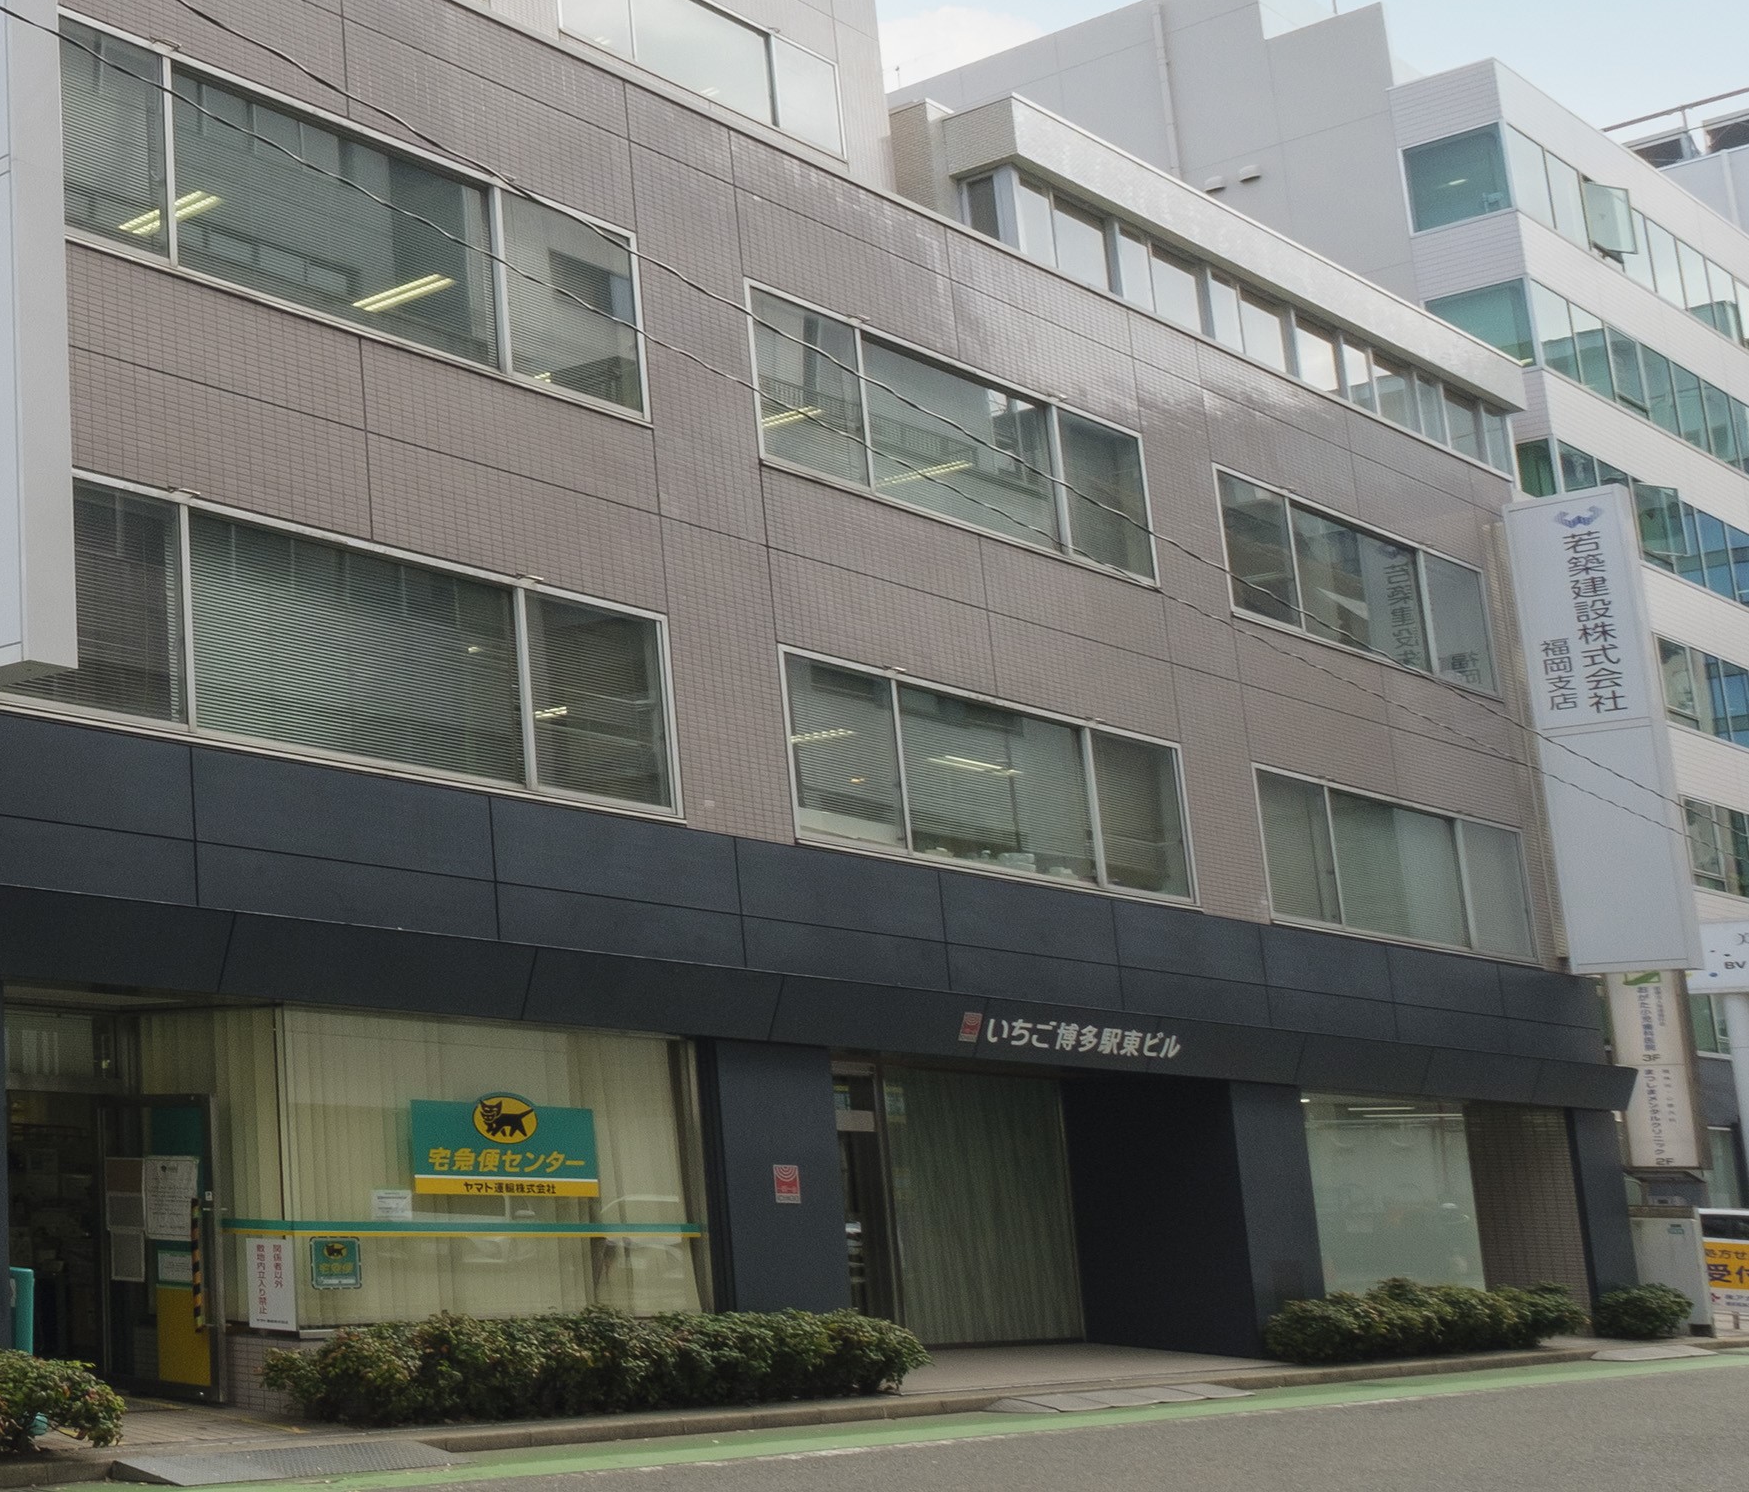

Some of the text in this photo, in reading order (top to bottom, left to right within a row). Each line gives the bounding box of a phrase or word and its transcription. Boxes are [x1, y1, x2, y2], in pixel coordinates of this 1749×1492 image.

[1562, 529, 1628, 714] 若築建設株式会社
[1540, 637, 1579, 711] 福岡支店
[986, 1018, 1181, 1058] いちご博多駅東ビル
[428, 1147, 585, 1173] 宅急便センター
[463, 1181, 556, 1195] ヤマト運輸株式会社
[256, 1244, 268, 1315] 敷地内立入り禁止
[273, 1244, 283, 1288] 関係者以外
